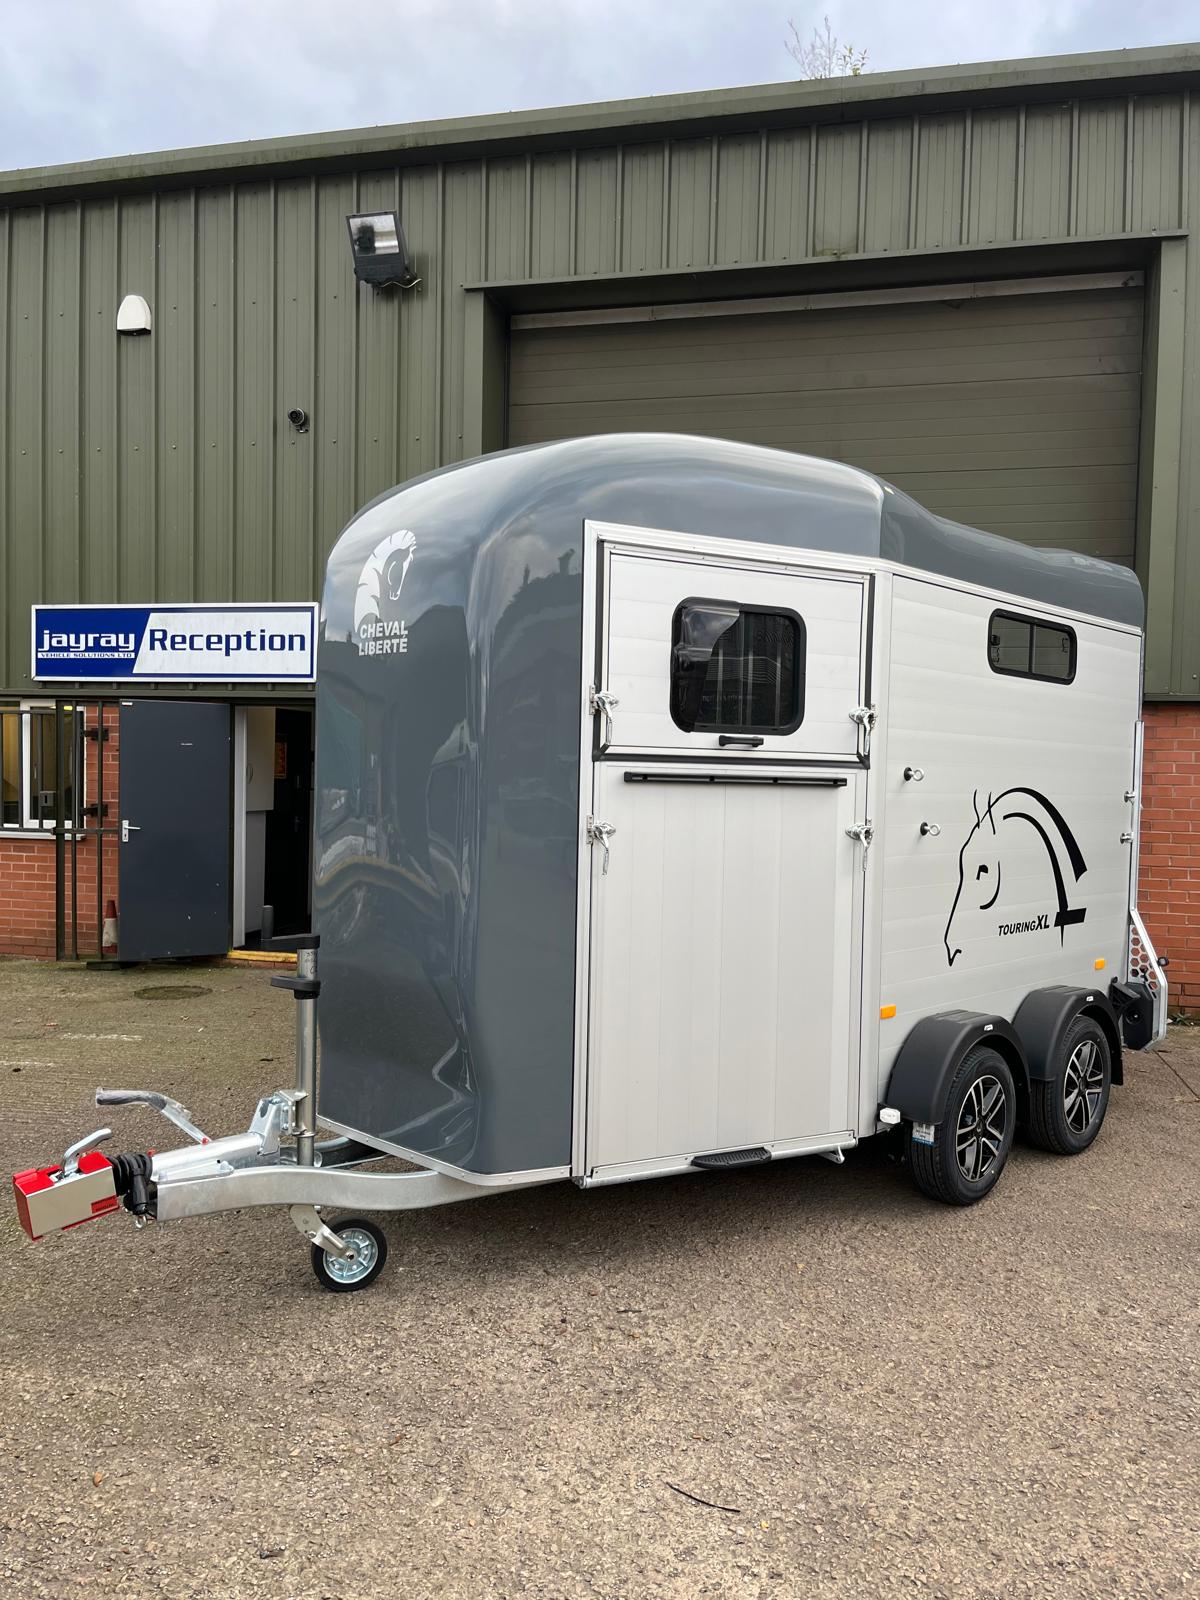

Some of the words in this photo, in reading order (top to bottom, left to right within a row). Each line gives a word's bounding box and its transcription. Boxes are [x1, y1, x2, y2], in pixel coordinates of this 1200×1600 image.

[38, 629, 135, 652] jayray
[360, 620, 409, 639] CHEVAL
[149, 628, 306, 657] Reception
[358, 634, 408, 656] LIBERTÉ
